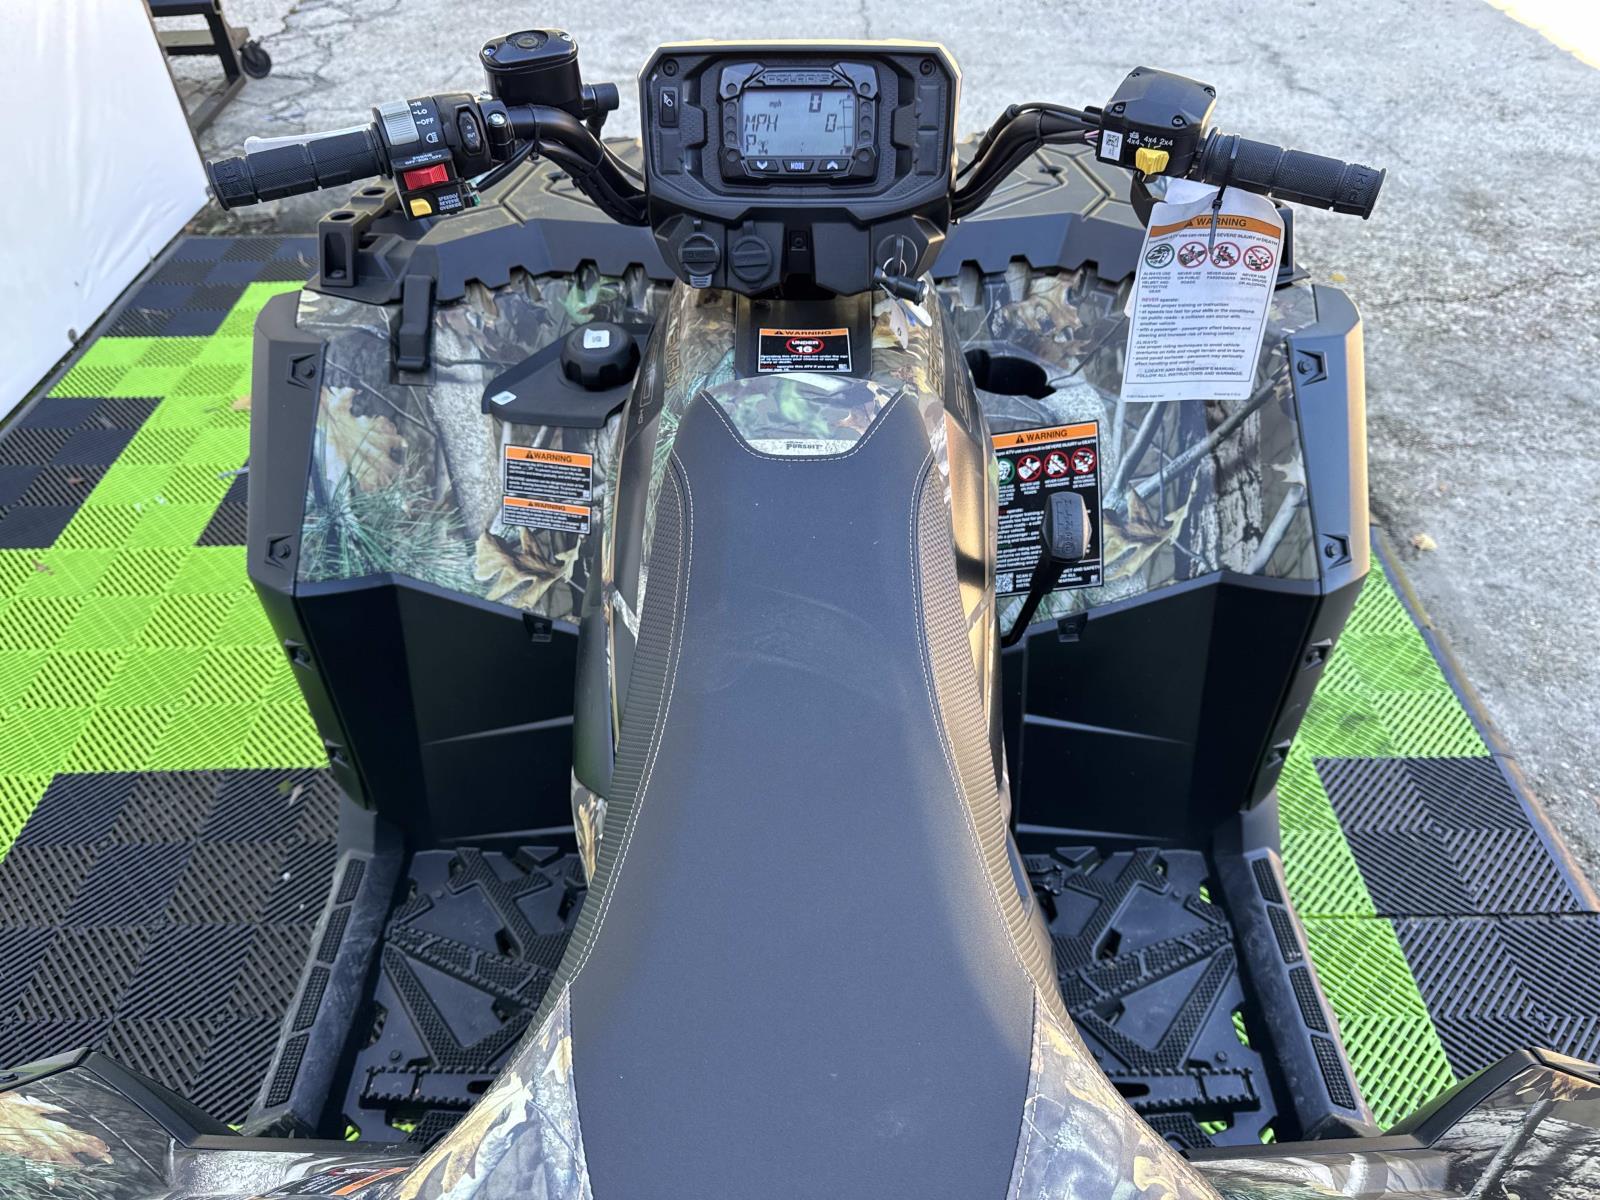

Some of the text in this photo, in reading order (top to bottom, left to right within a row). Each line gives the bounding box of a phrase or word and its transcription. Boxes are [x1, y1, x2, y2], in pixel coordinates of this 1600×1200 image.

[769, 100, 782, 108] mph
[744, 114, 779, 132] MPH
[746, 134, 757, 152] P
[1144, 136, 1174, 146] 4x4 2x4
[790, 162, 805, 170] MODE
[1196, 218, 1247, 228] WARNING
[1026, 429, 1068, 441] WARNING
[534, 452, 572, 462] WARNING
[534, 502, 566, 511] WARNING
